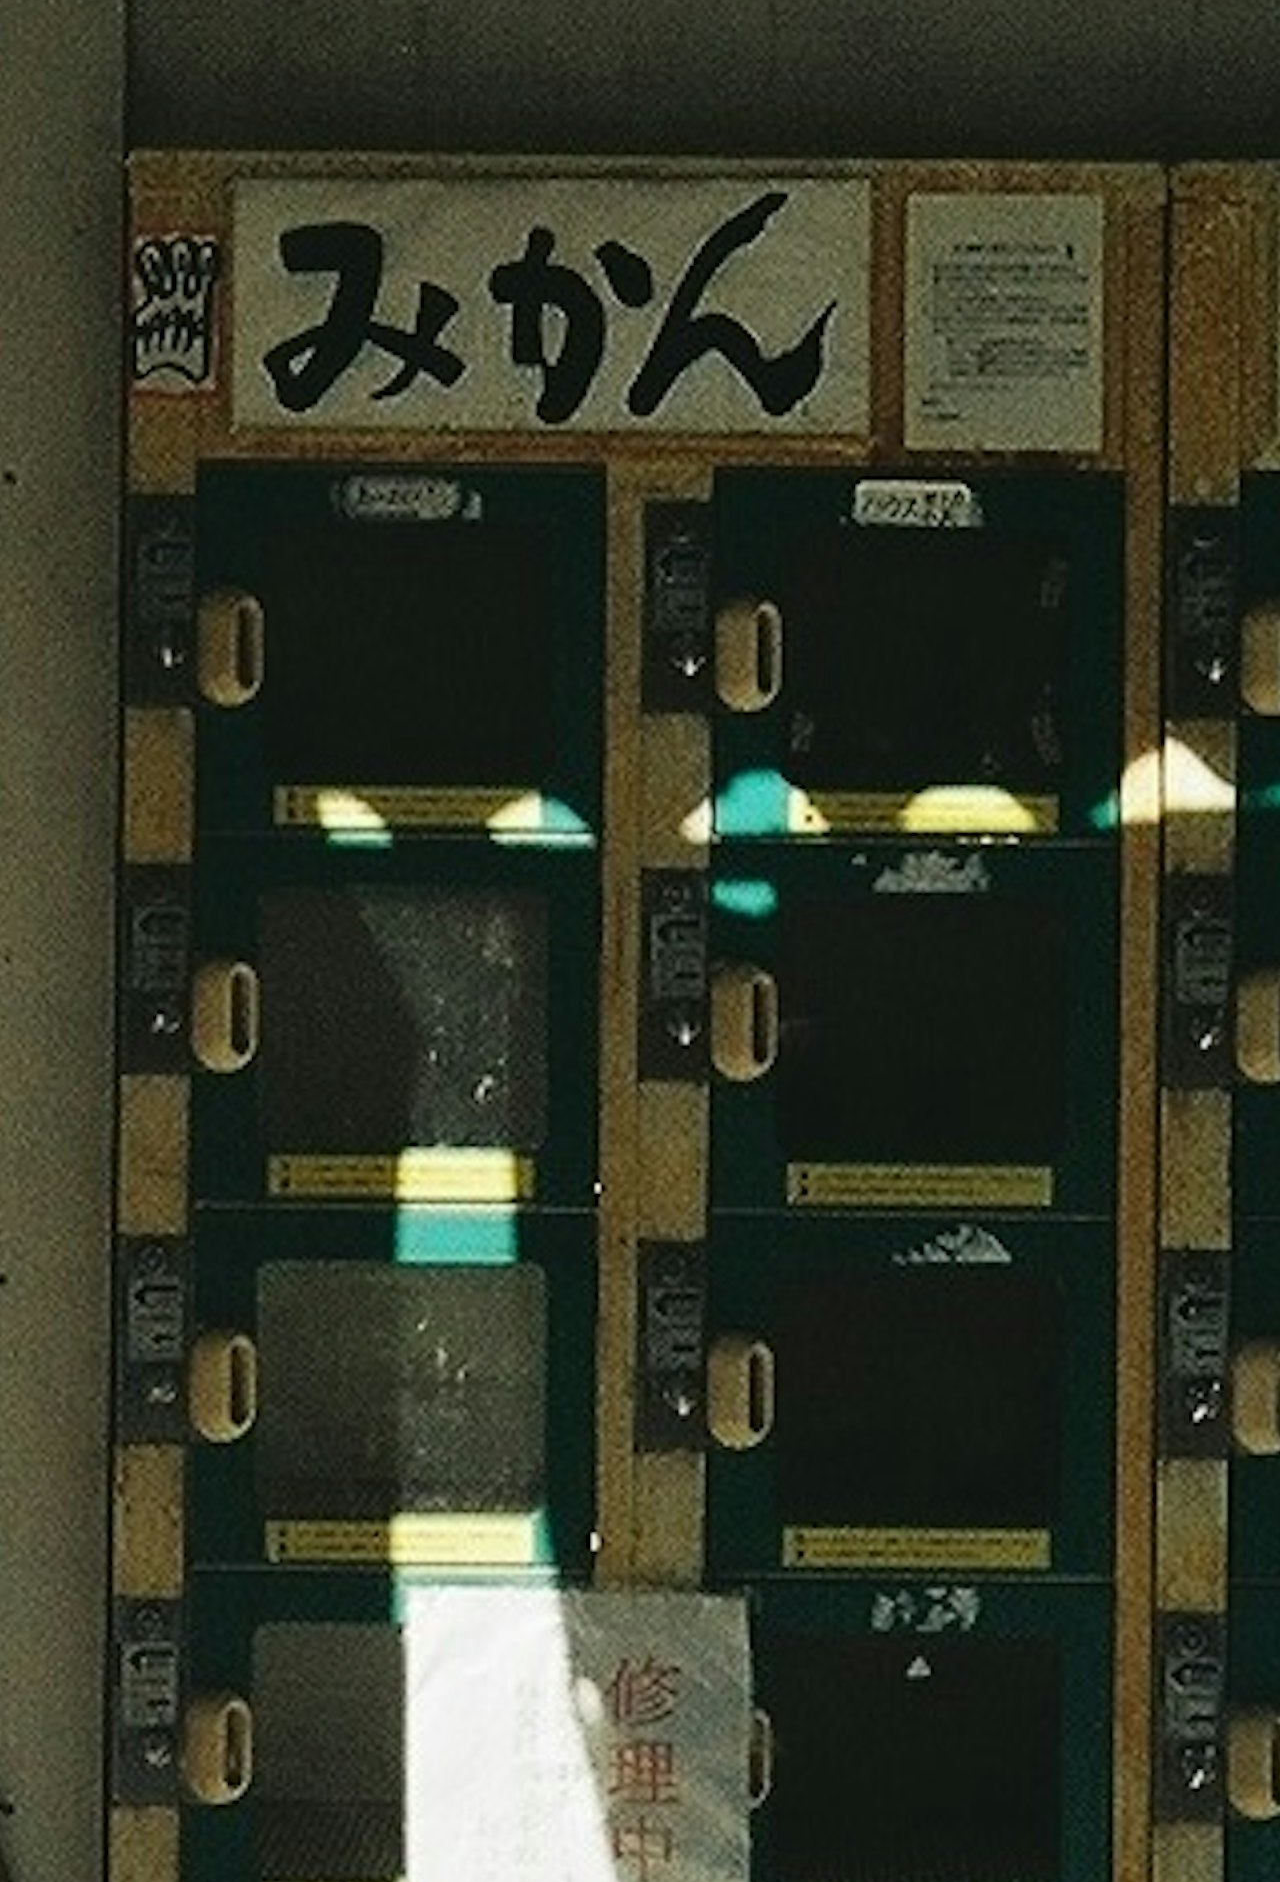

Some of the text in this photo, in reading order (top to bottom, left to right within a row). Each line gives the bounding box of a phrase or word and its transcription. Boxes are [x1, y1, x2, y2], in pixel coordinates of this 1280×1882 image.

[263, 192, 838, 423] みかん
[606, 1656, 681, 1882] 修理中
